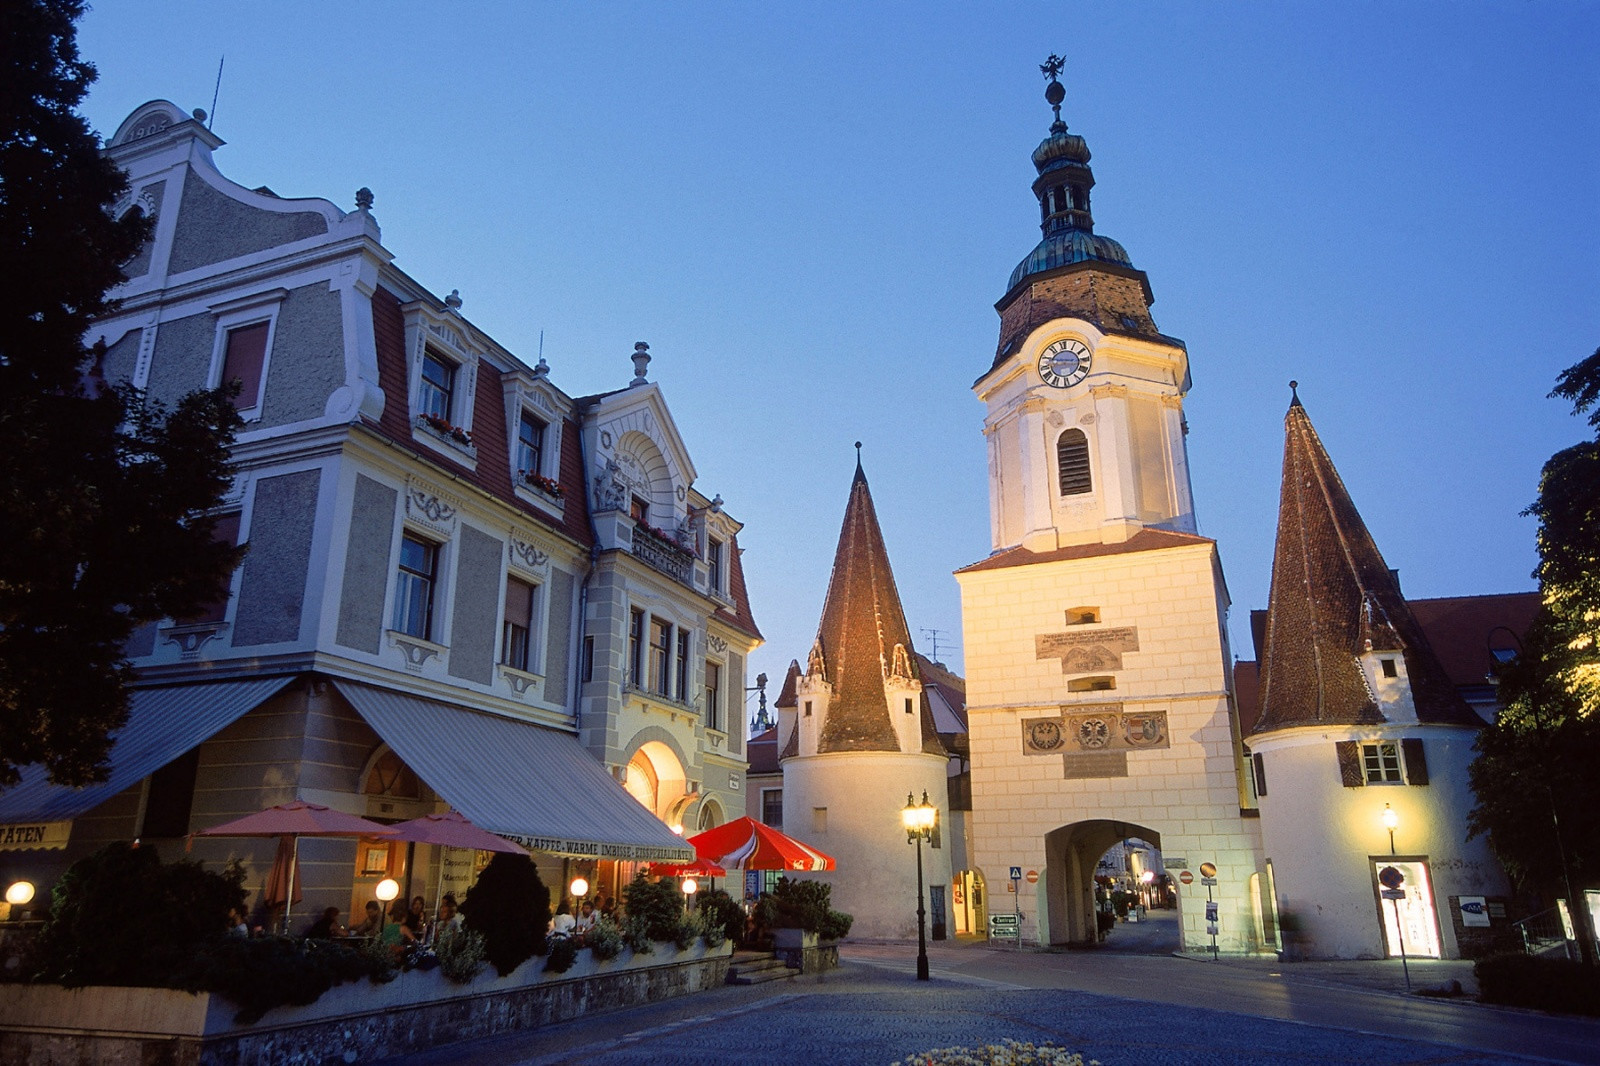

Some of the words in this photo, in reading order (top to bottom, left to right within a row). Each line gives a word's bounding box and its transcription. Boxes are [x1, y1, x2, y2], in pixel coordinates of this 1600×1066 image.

[526, 837, 562, 853] KAFFEE
[566, 841, 598, 855] WARME
[601, 843, 631, 858] IMBISSE
